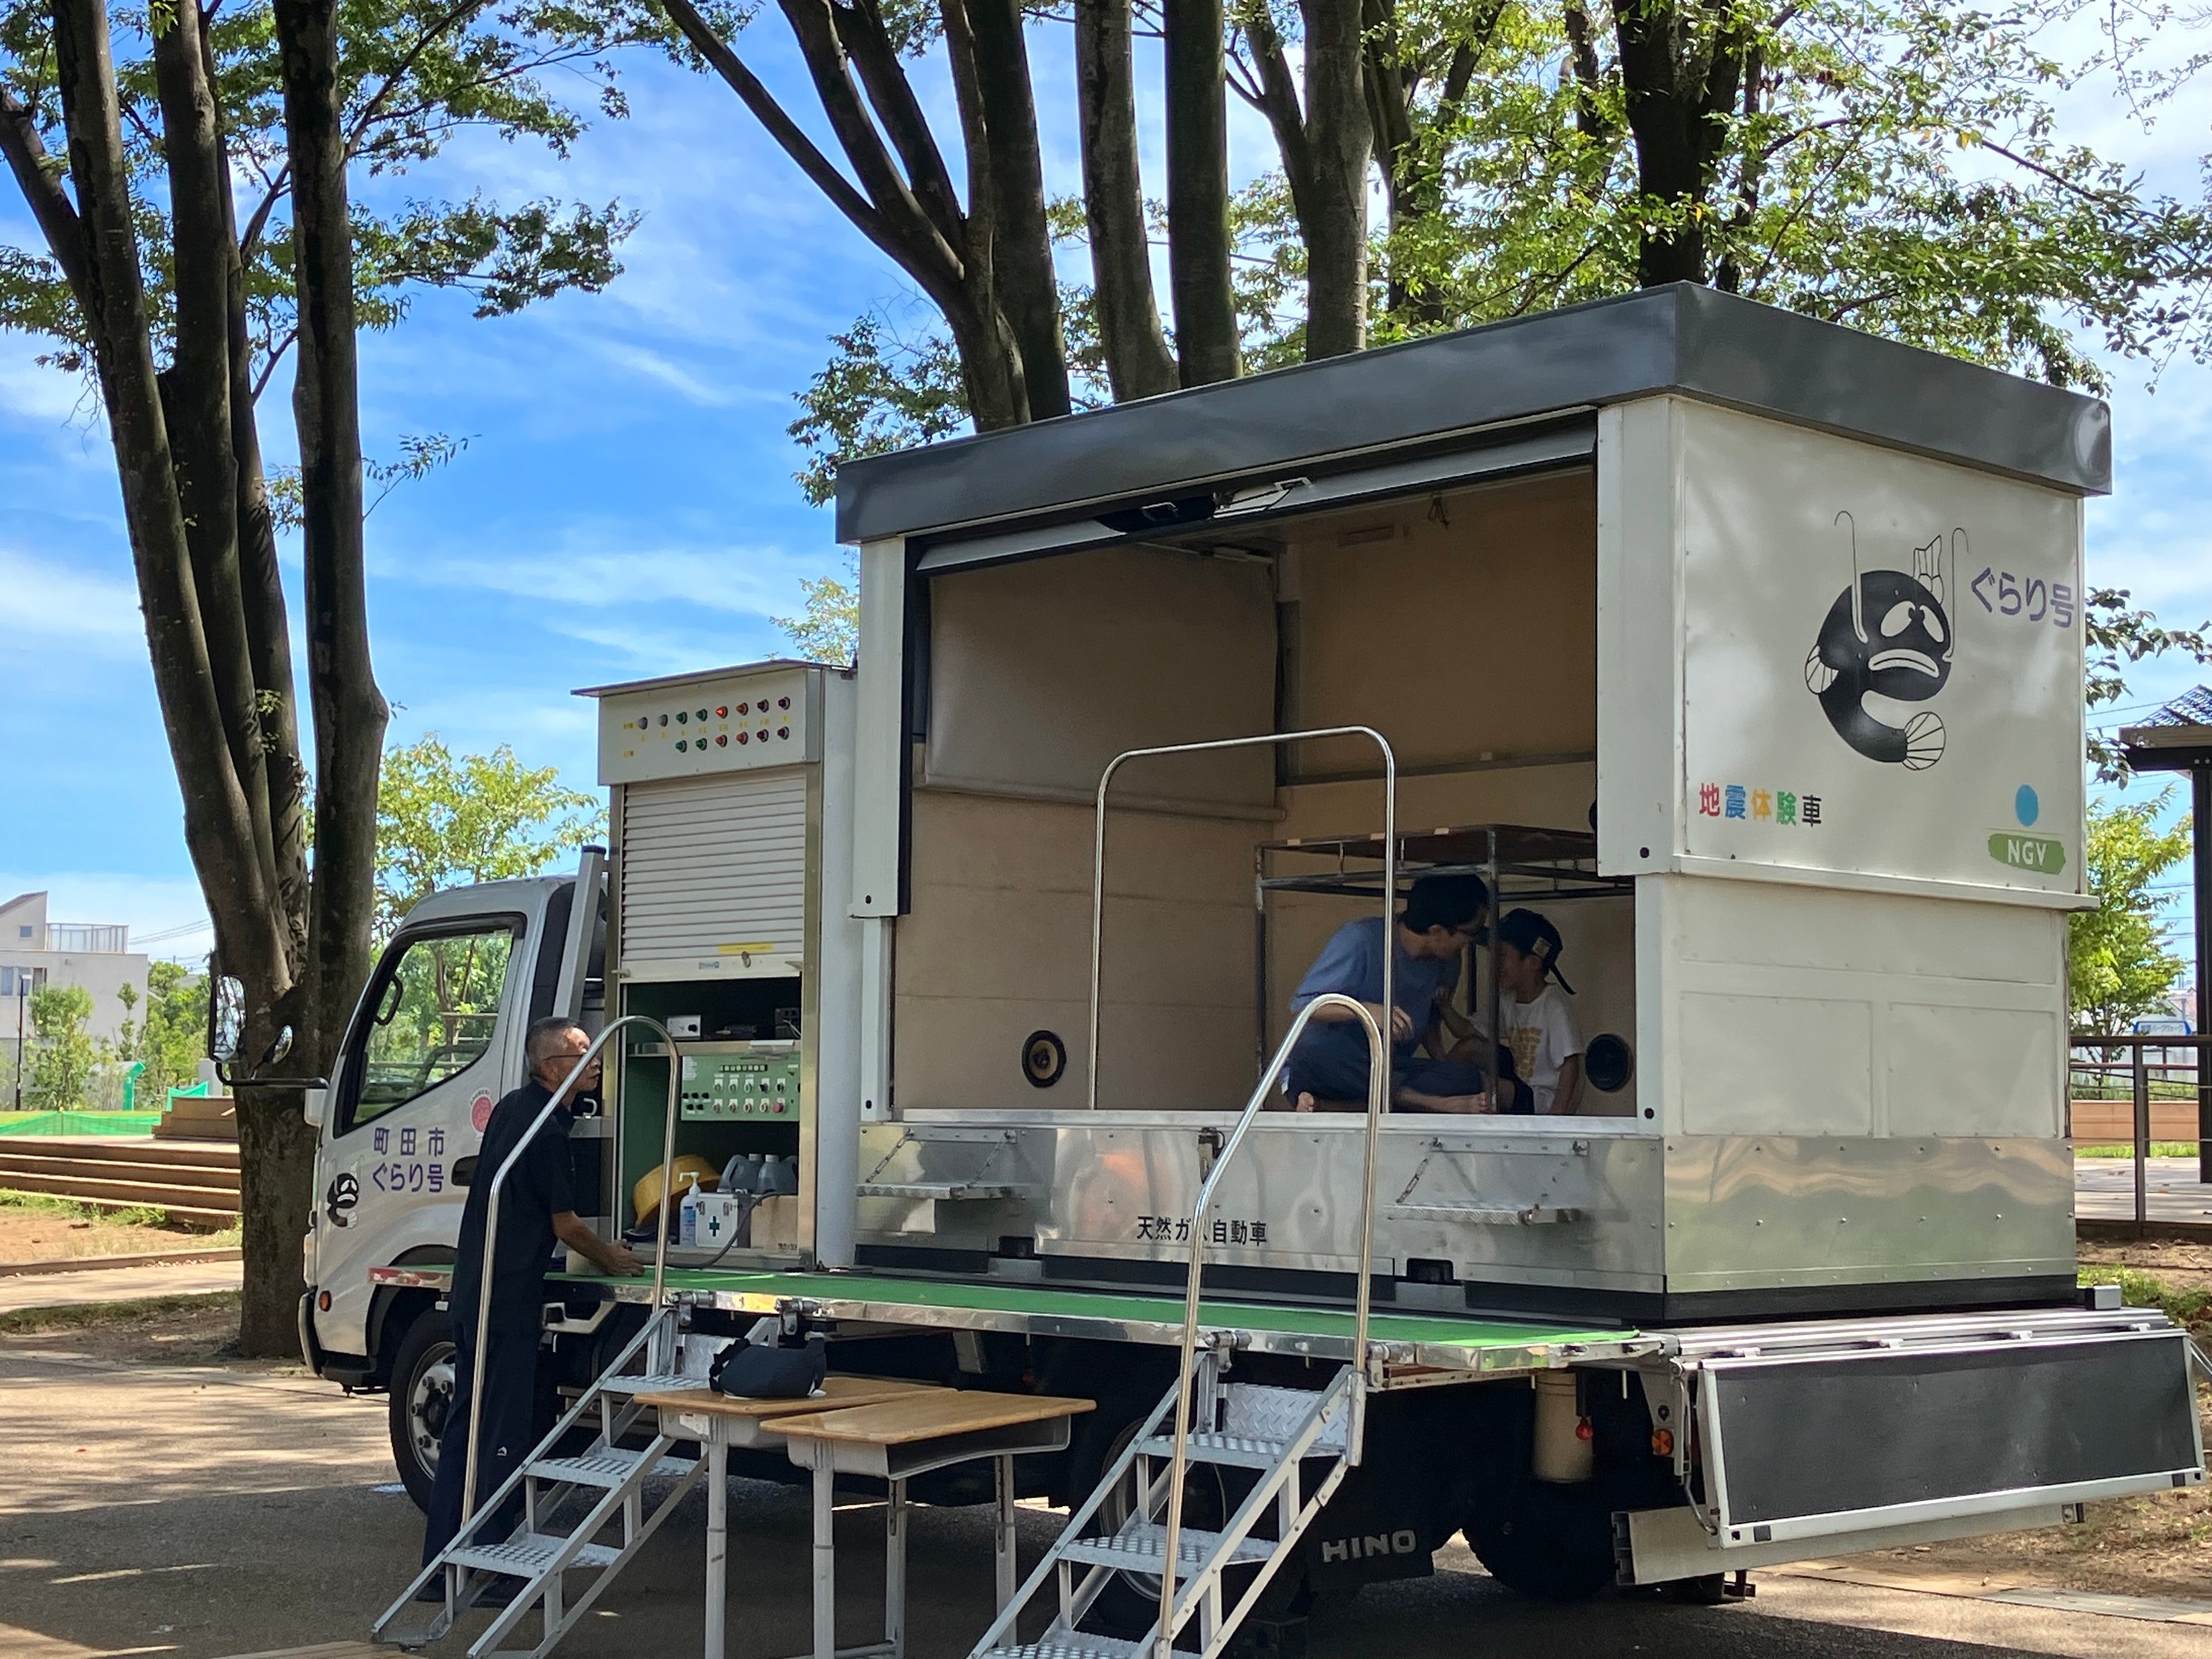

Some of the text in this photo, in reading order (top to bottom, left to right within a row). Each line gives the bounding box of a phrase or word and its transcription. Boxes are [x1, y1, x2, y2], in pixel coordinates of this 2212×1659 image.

[1971, 567, 2075, 628] ぐらり号
[1699, 782, 1822, 828] 地震体験車
[2008, 839, 2047, 867] NGV
[374, 1127, 444, 1157] 町田市
[373, 1162, 444, 1192] ぐらり号
[1137, 1215, 1267, 1247] 天然ガ自動車
[1322, 1530, 1416, 1563] HINO
